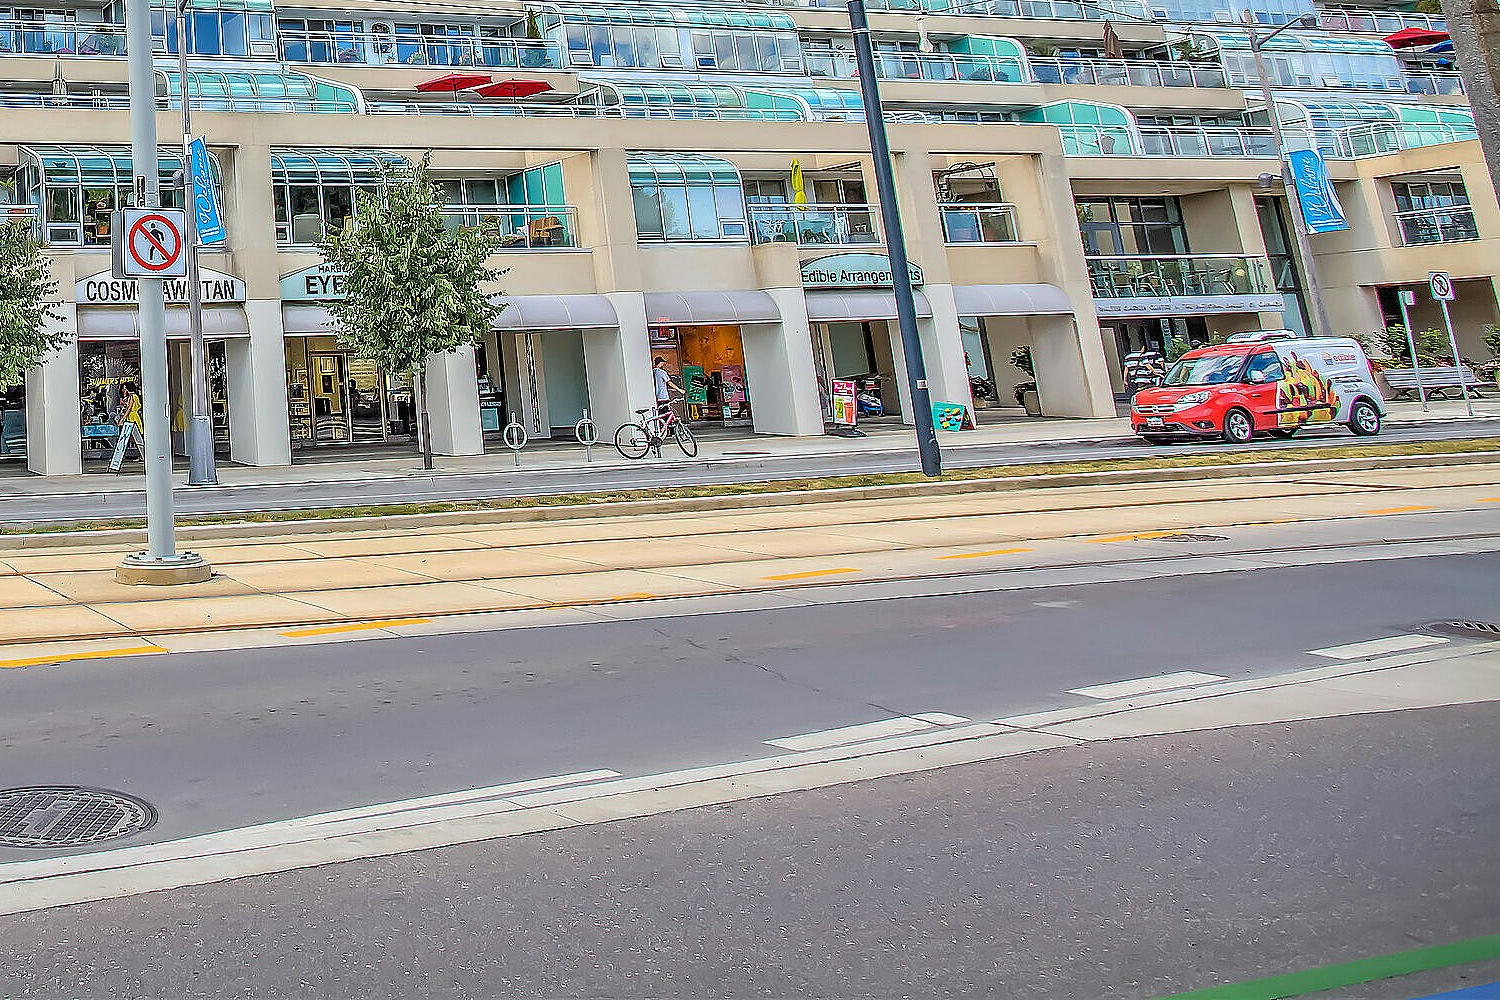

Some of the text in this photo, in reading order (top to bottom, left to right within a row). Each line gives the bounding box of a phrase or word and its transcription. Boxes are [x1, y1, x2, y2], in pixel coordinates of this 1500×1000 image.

[801, 269, 921, 284] Edible Arrangets
[86, 280, 235, 301] COSMAWTAN
